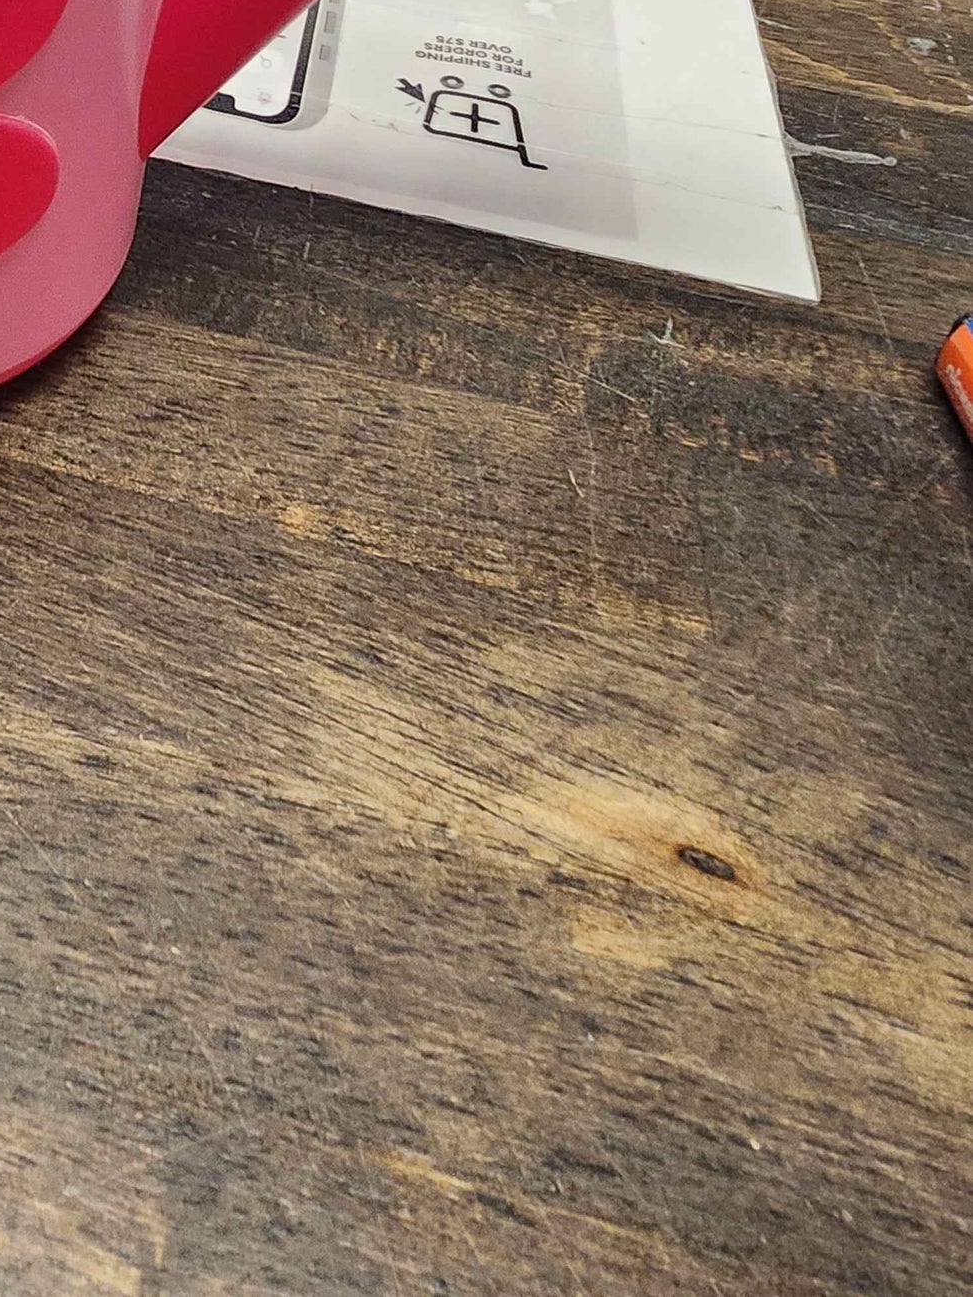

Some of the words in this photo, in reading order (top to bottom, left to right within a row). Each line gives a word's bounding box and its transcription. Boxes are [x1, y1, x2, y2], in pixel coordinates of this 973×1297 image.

[435, 34, 465, 46] $75
[468, 39, 513, 54] OVER
[423, 42, 488, 58] ORDERS
[414, 49, 492, 69] SHIPPING
[491, 52, 524, 67] FOR
[494, 62, 532, 79] FREE
